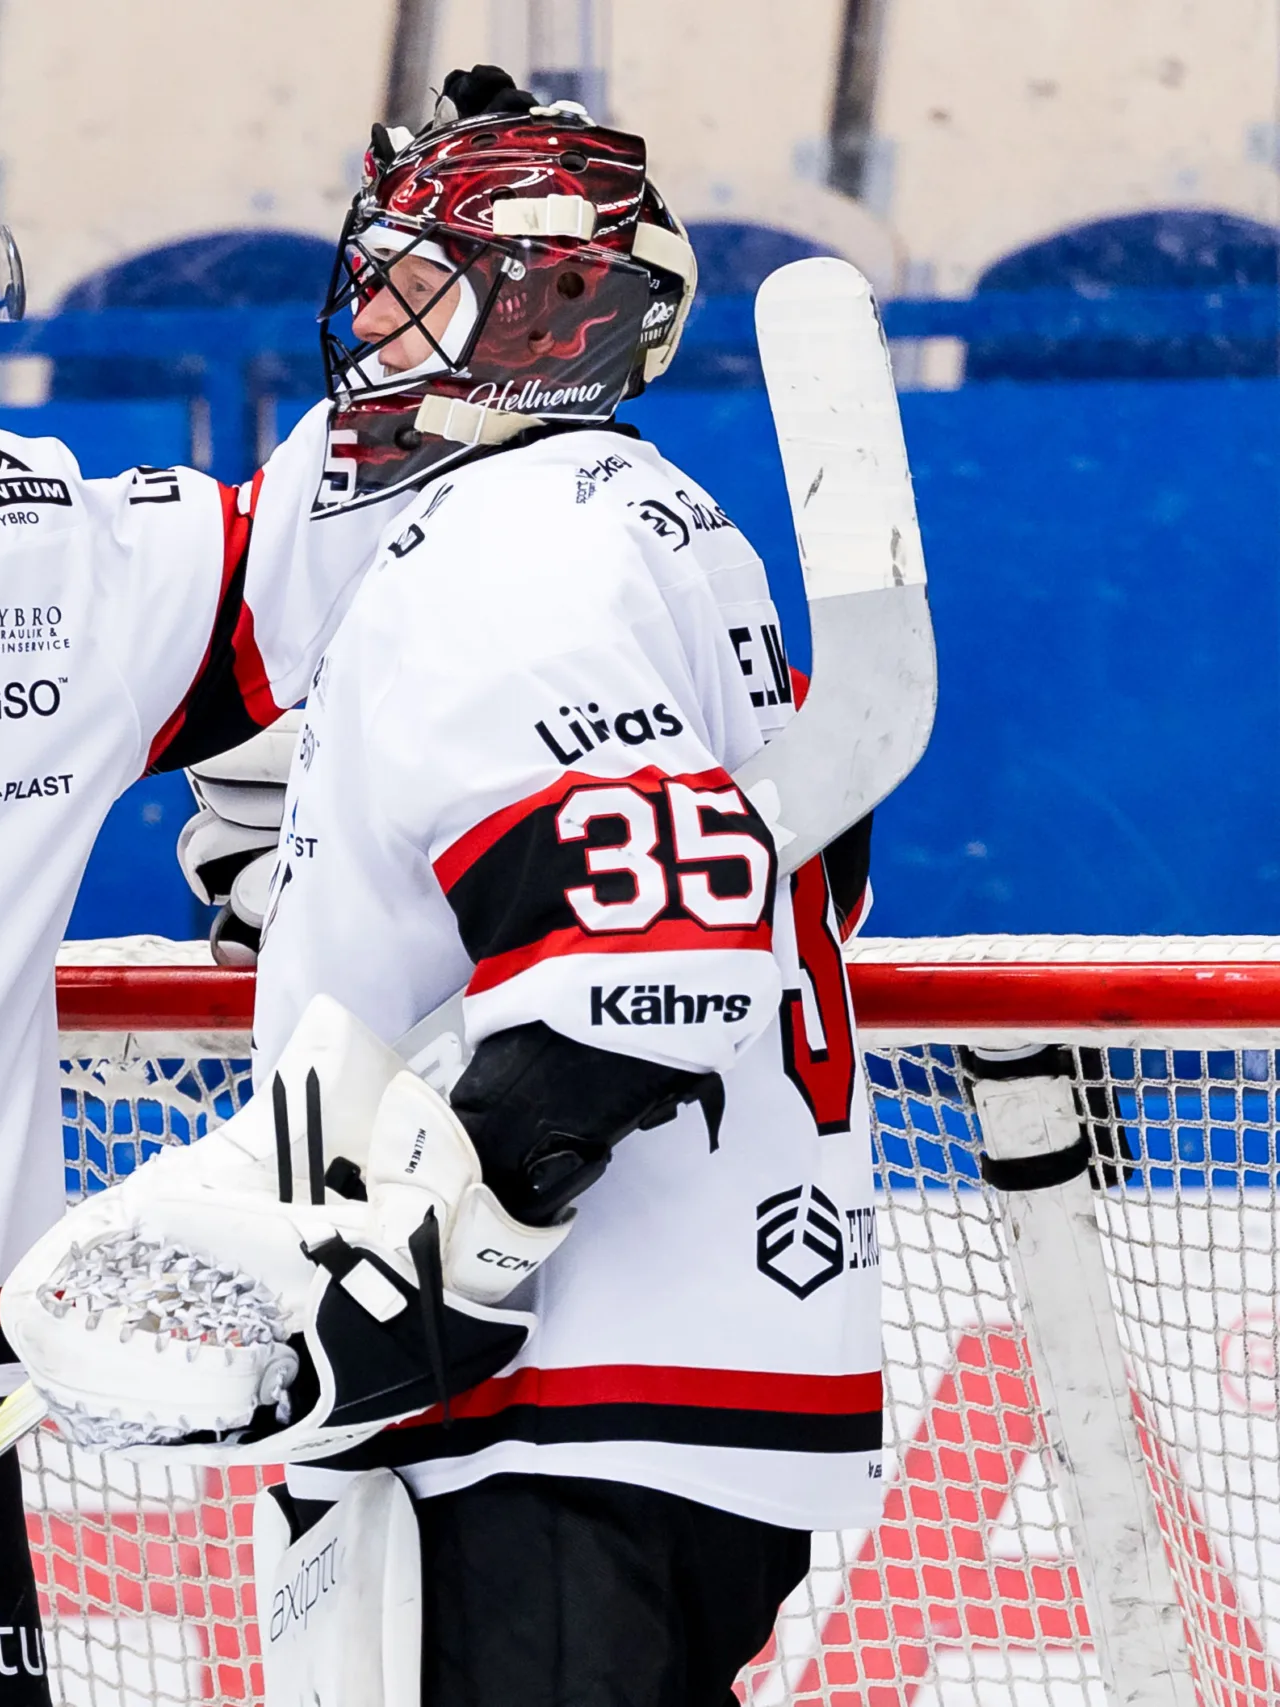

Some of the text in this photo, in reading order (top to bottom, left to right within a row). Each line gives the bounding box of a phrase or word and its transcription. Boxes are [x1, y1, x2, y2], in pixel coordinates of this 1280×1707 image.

[467, 378, 606, 412] Hellnemo
[49, 627, 58, 638] &
[554, 775, 772, 936] 35
[590, 984, 752, 1026] Kährs
[476, 1248, 539, 1272] CCM
